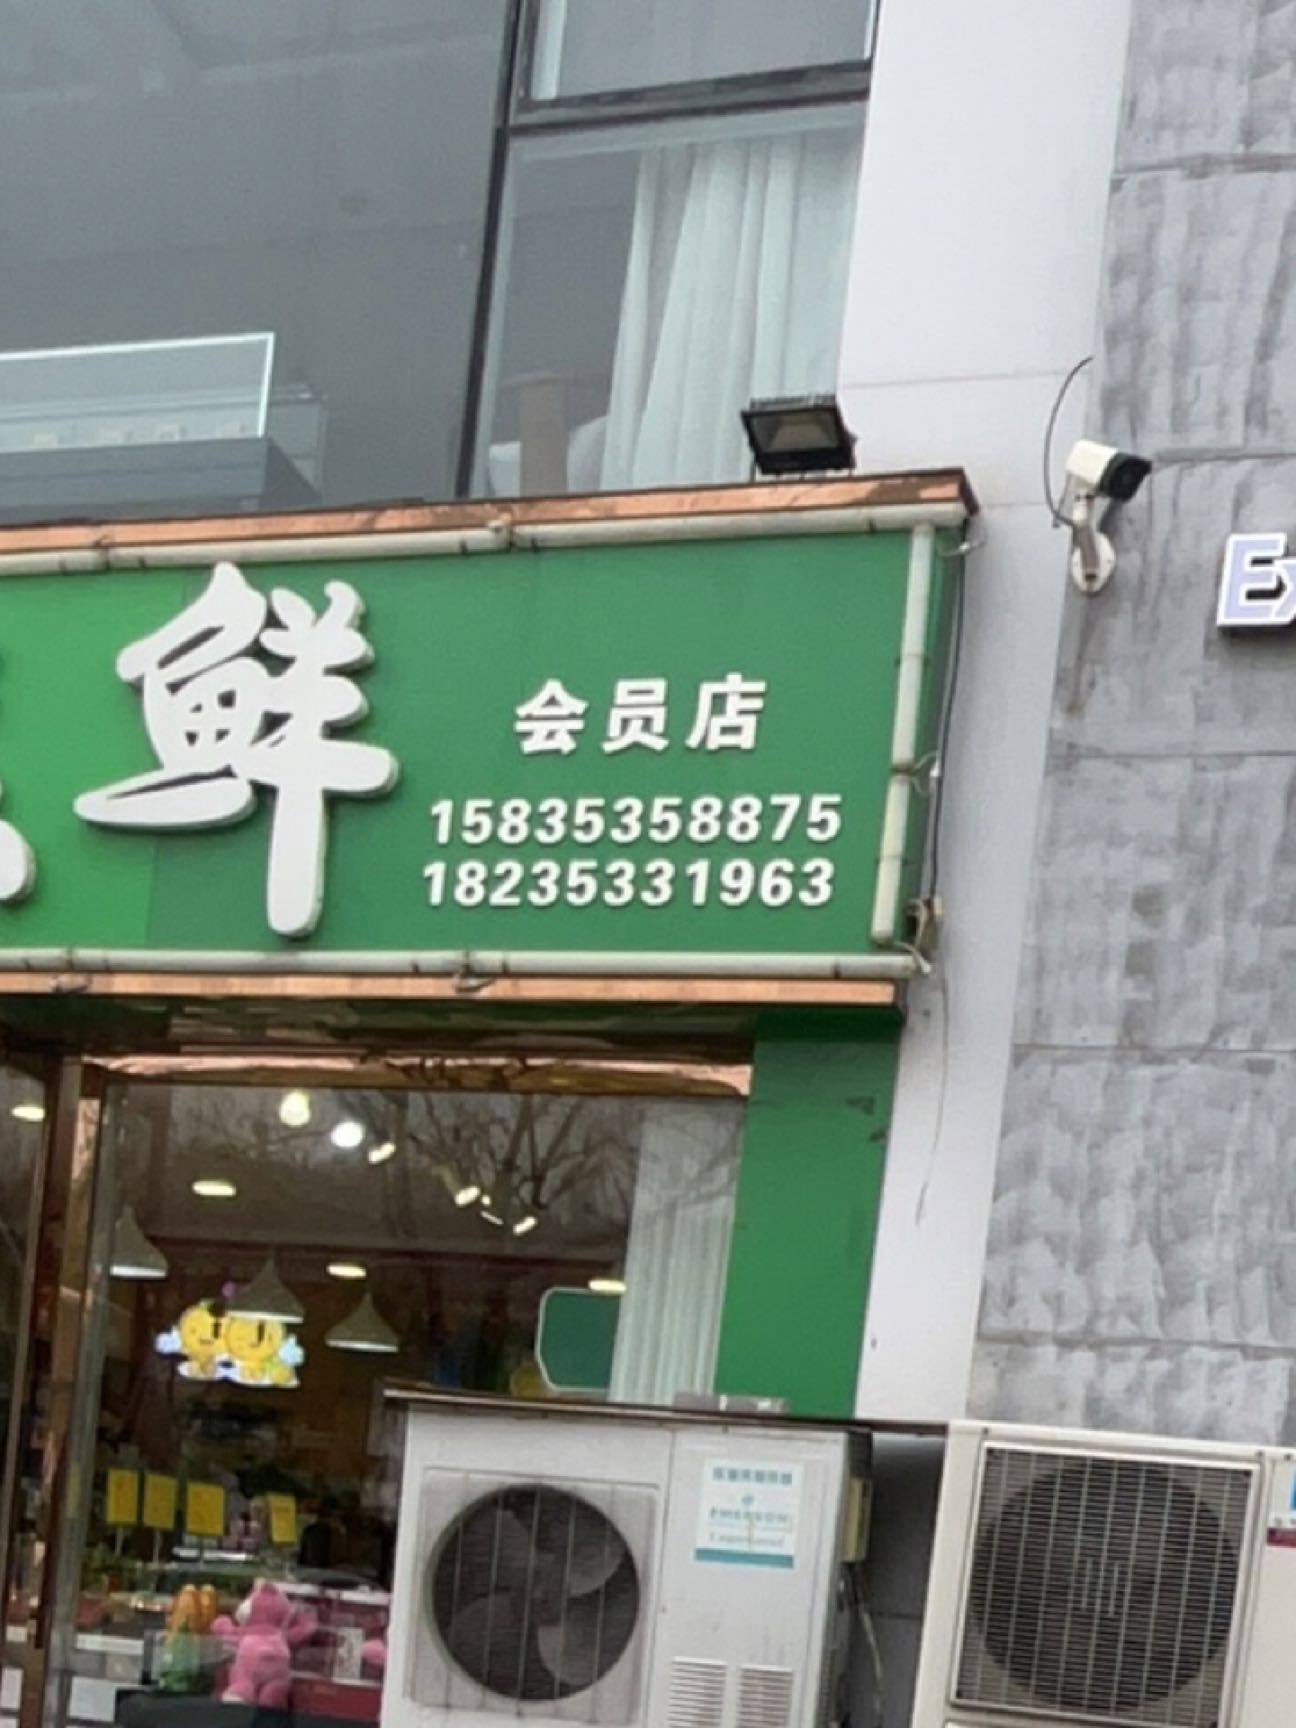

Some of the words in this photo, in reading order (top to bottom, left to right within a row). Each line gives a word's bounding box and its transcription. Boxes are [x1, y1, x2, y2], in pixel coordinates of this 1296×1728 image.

[514, 672, 767, 755] 会员店
[430, 793, 844, 845] 15835358875
[422, 857, 836, 908] 18235331963
